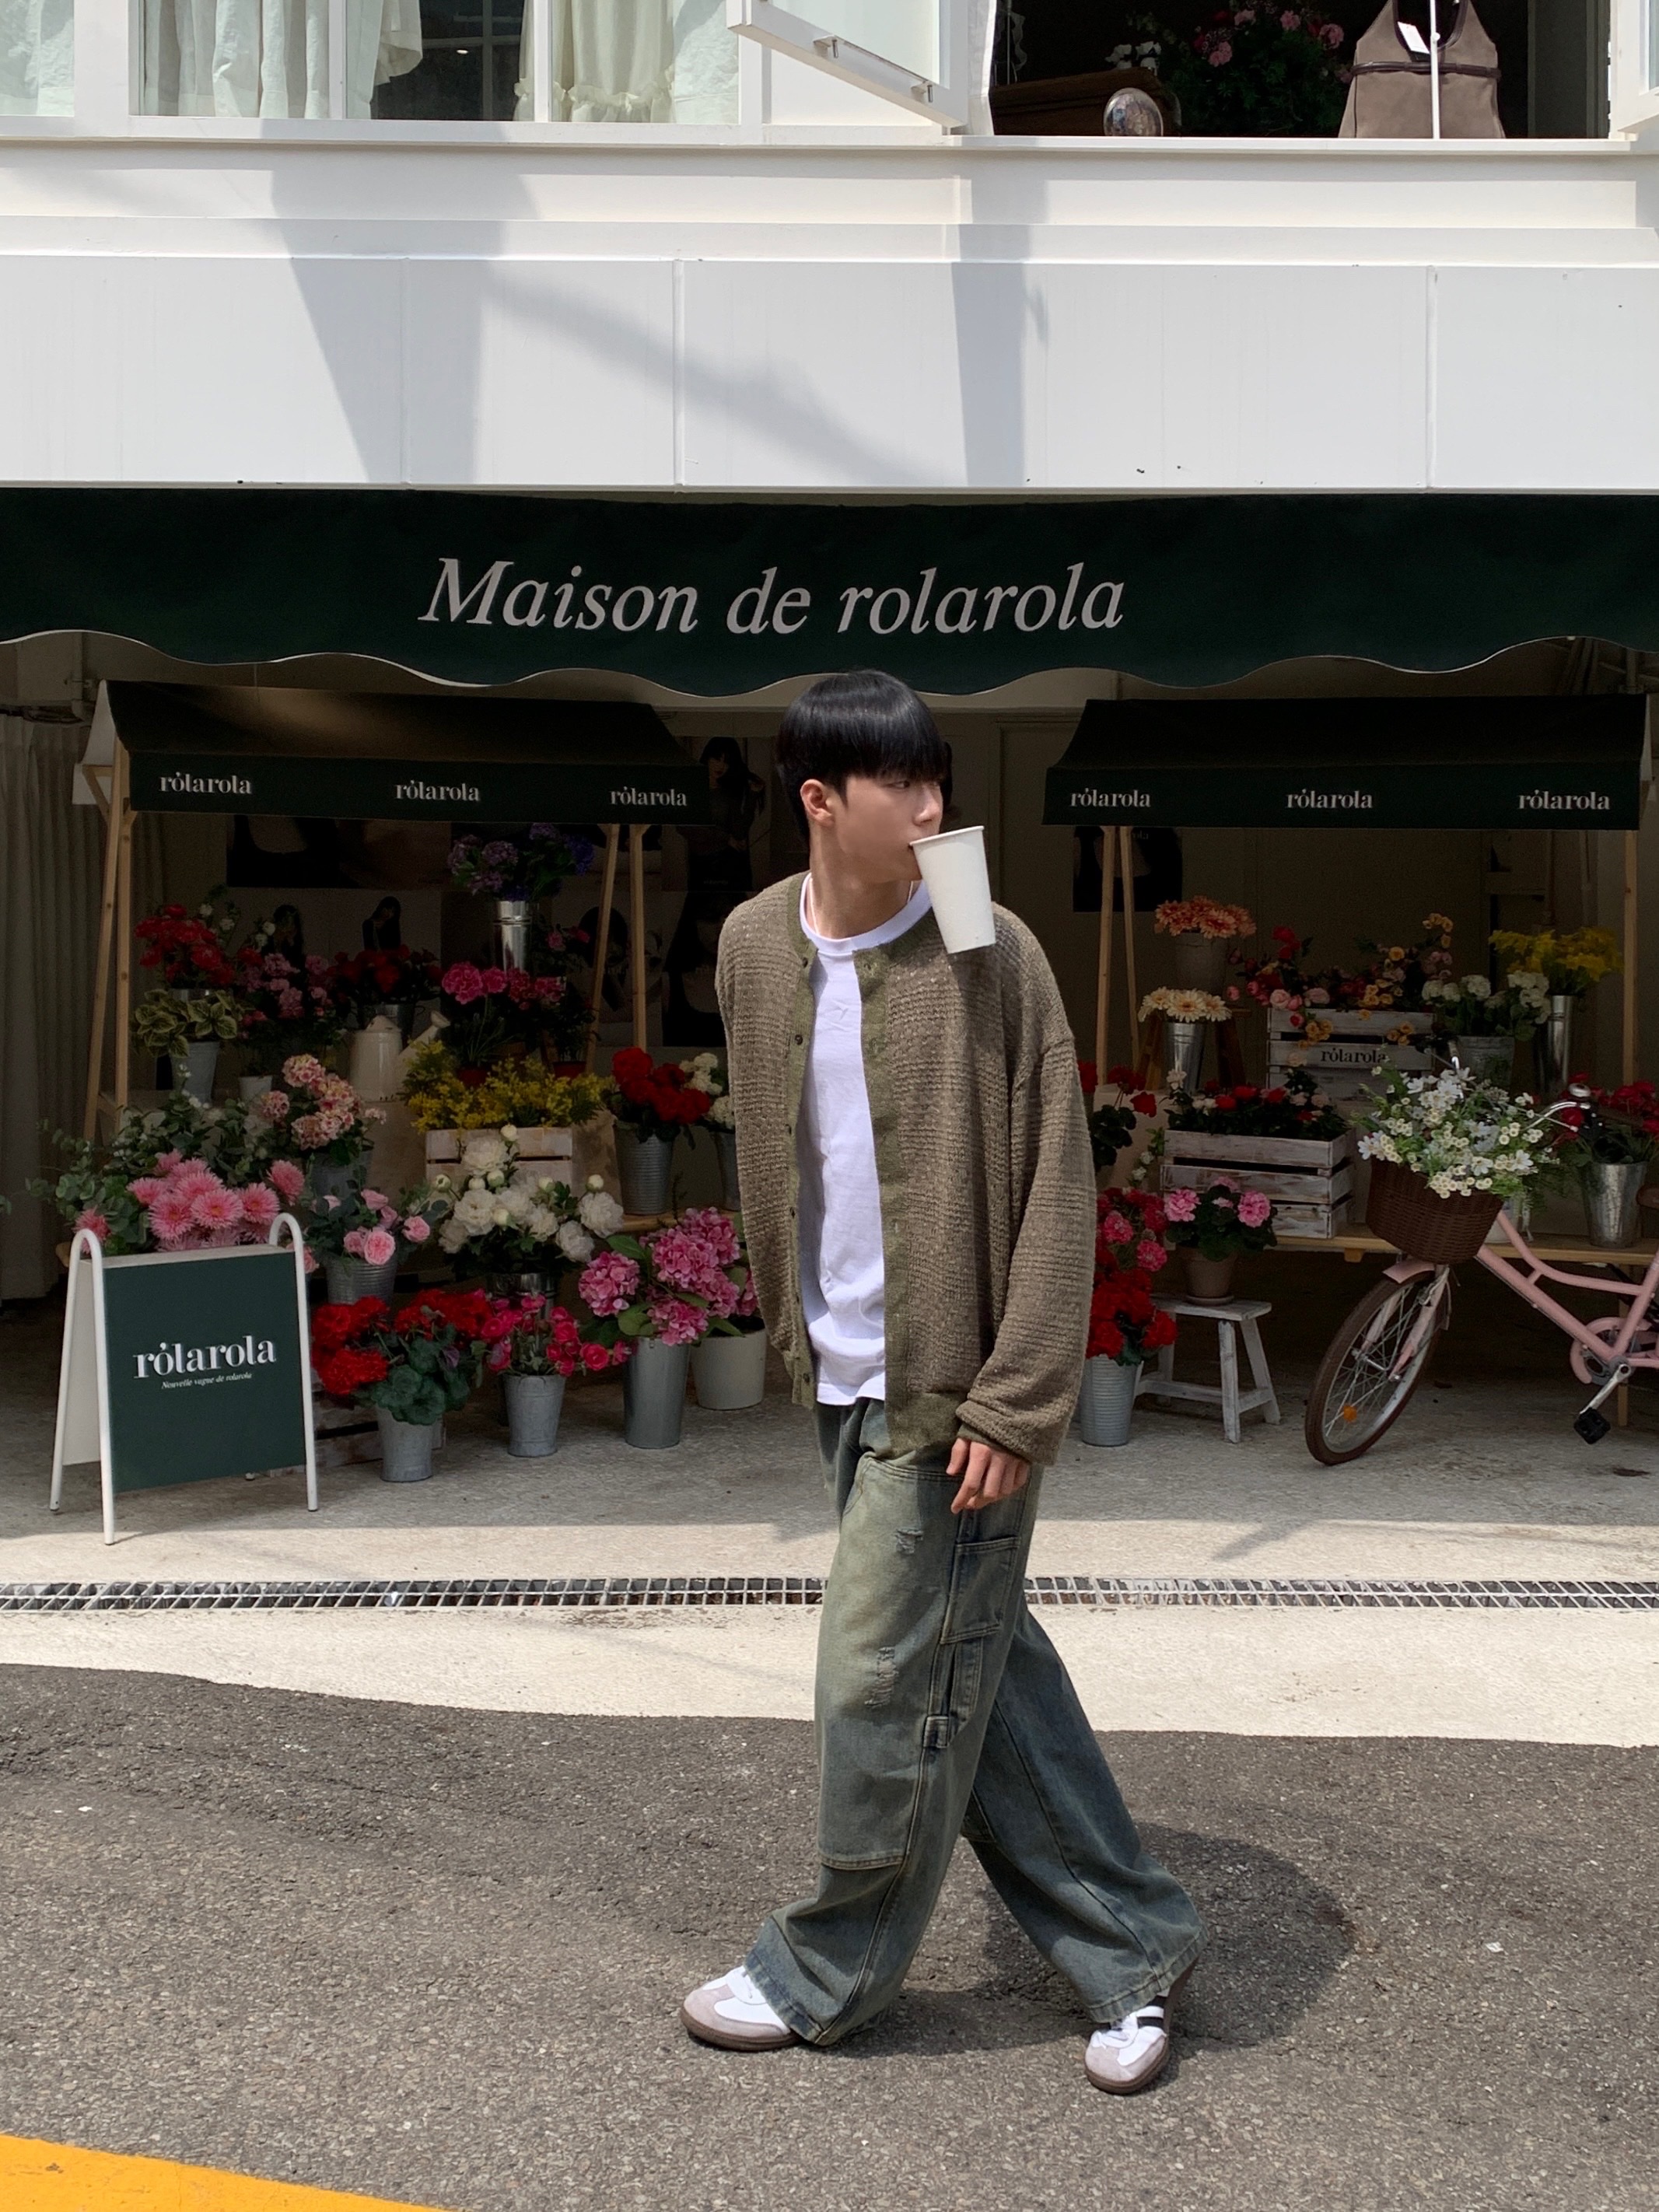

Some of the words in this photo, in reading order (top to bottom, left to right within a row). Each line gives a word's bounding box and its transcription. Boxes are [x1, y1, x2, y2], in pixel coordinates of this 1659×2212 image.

[417, 558, 698, 633] Maison
[726, 566, 811, 635] de
[837, 562, 1125, 635] rolarola
